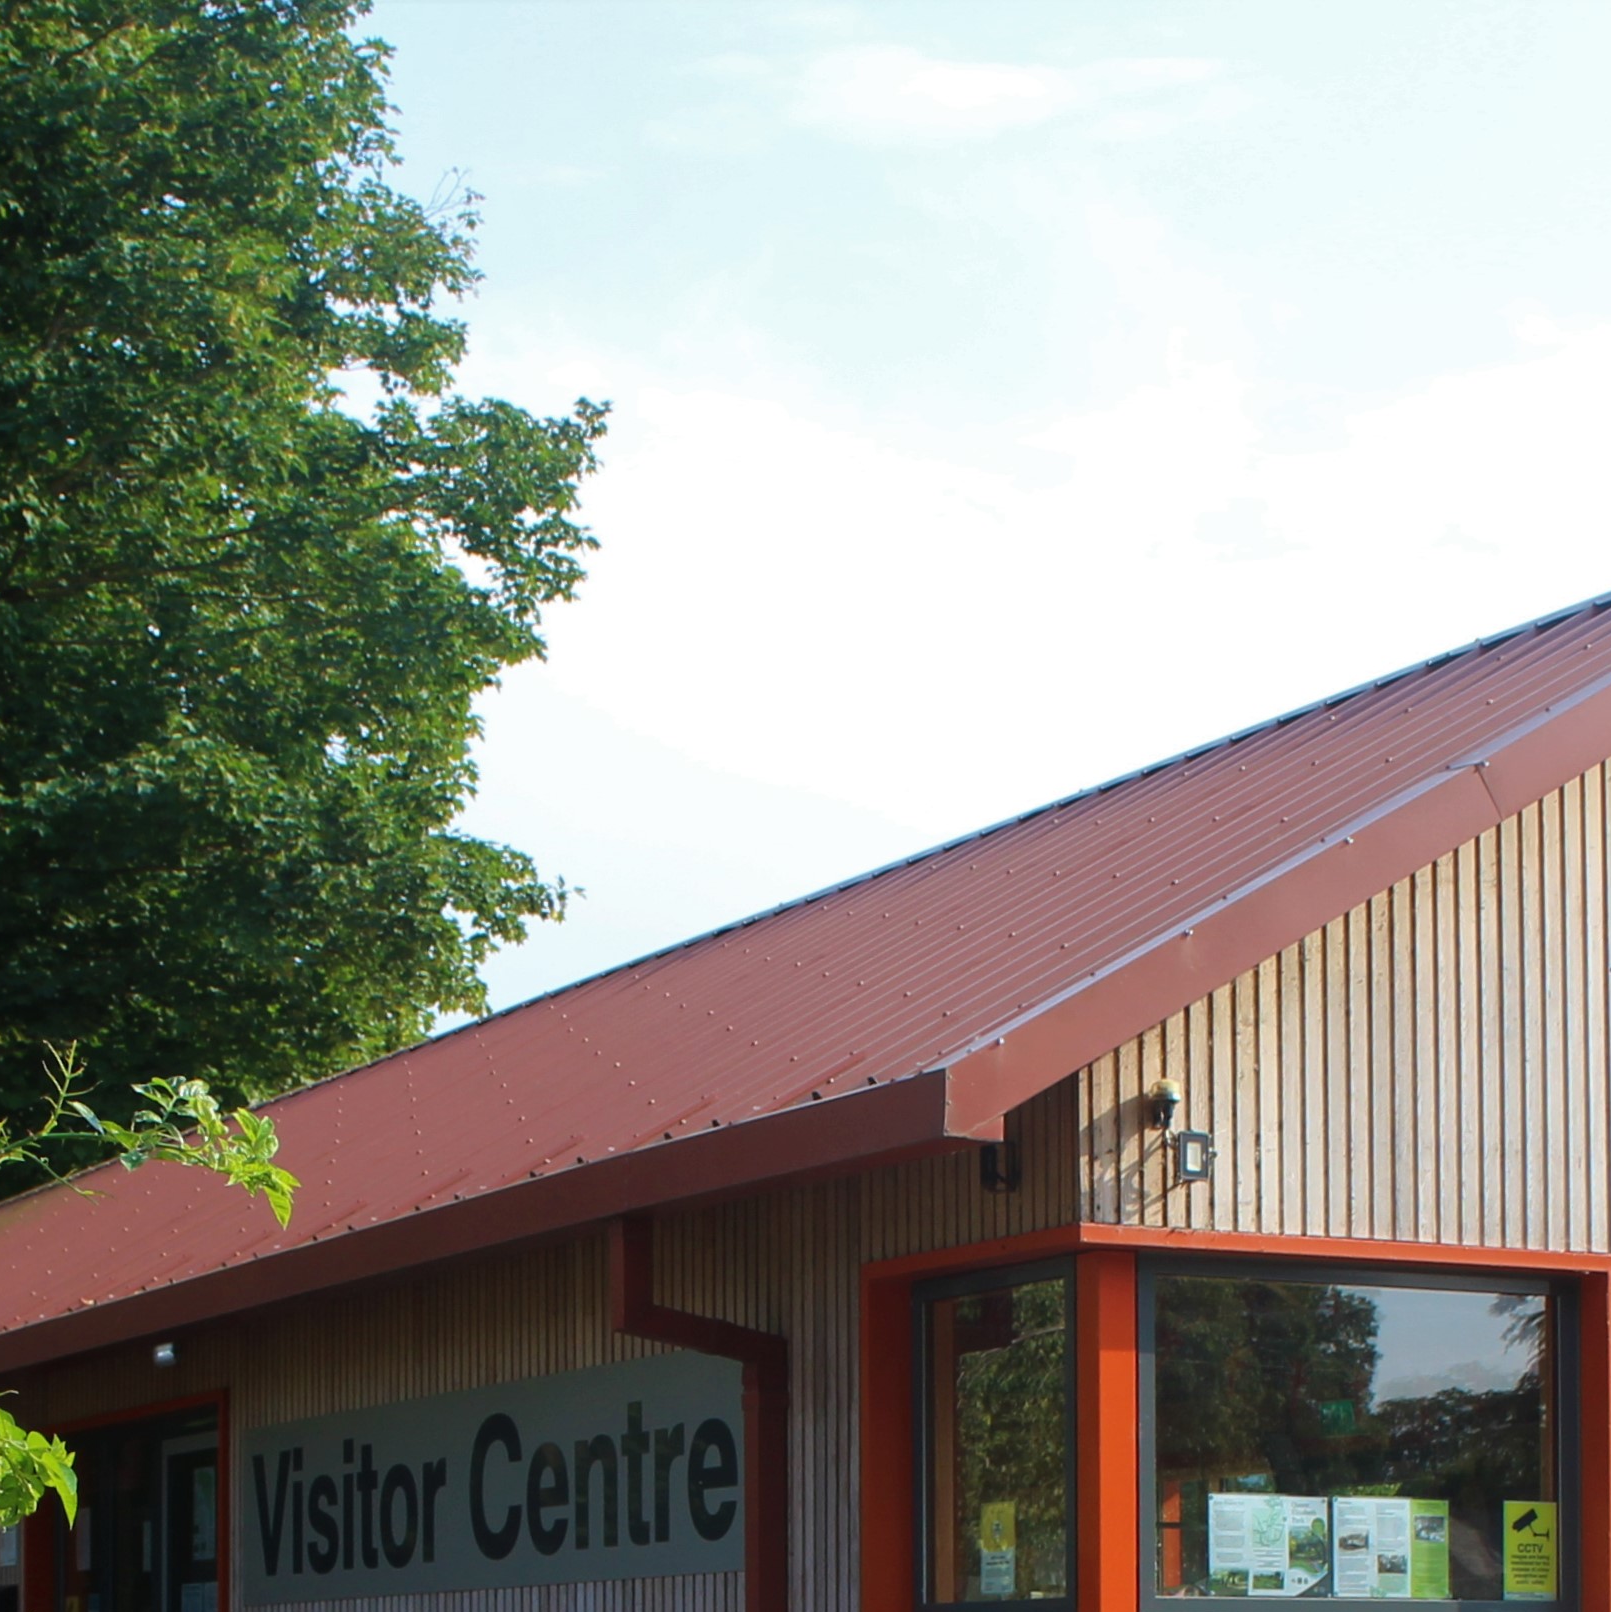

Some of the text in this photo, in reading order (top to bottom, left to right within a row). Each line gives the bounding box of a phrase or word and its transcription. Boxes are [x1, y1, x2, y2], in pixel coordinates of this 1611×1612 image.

[252, 1400, 739, 1577] Visitor Centre
[1517, 1543, 1544, 1553] CCTV
